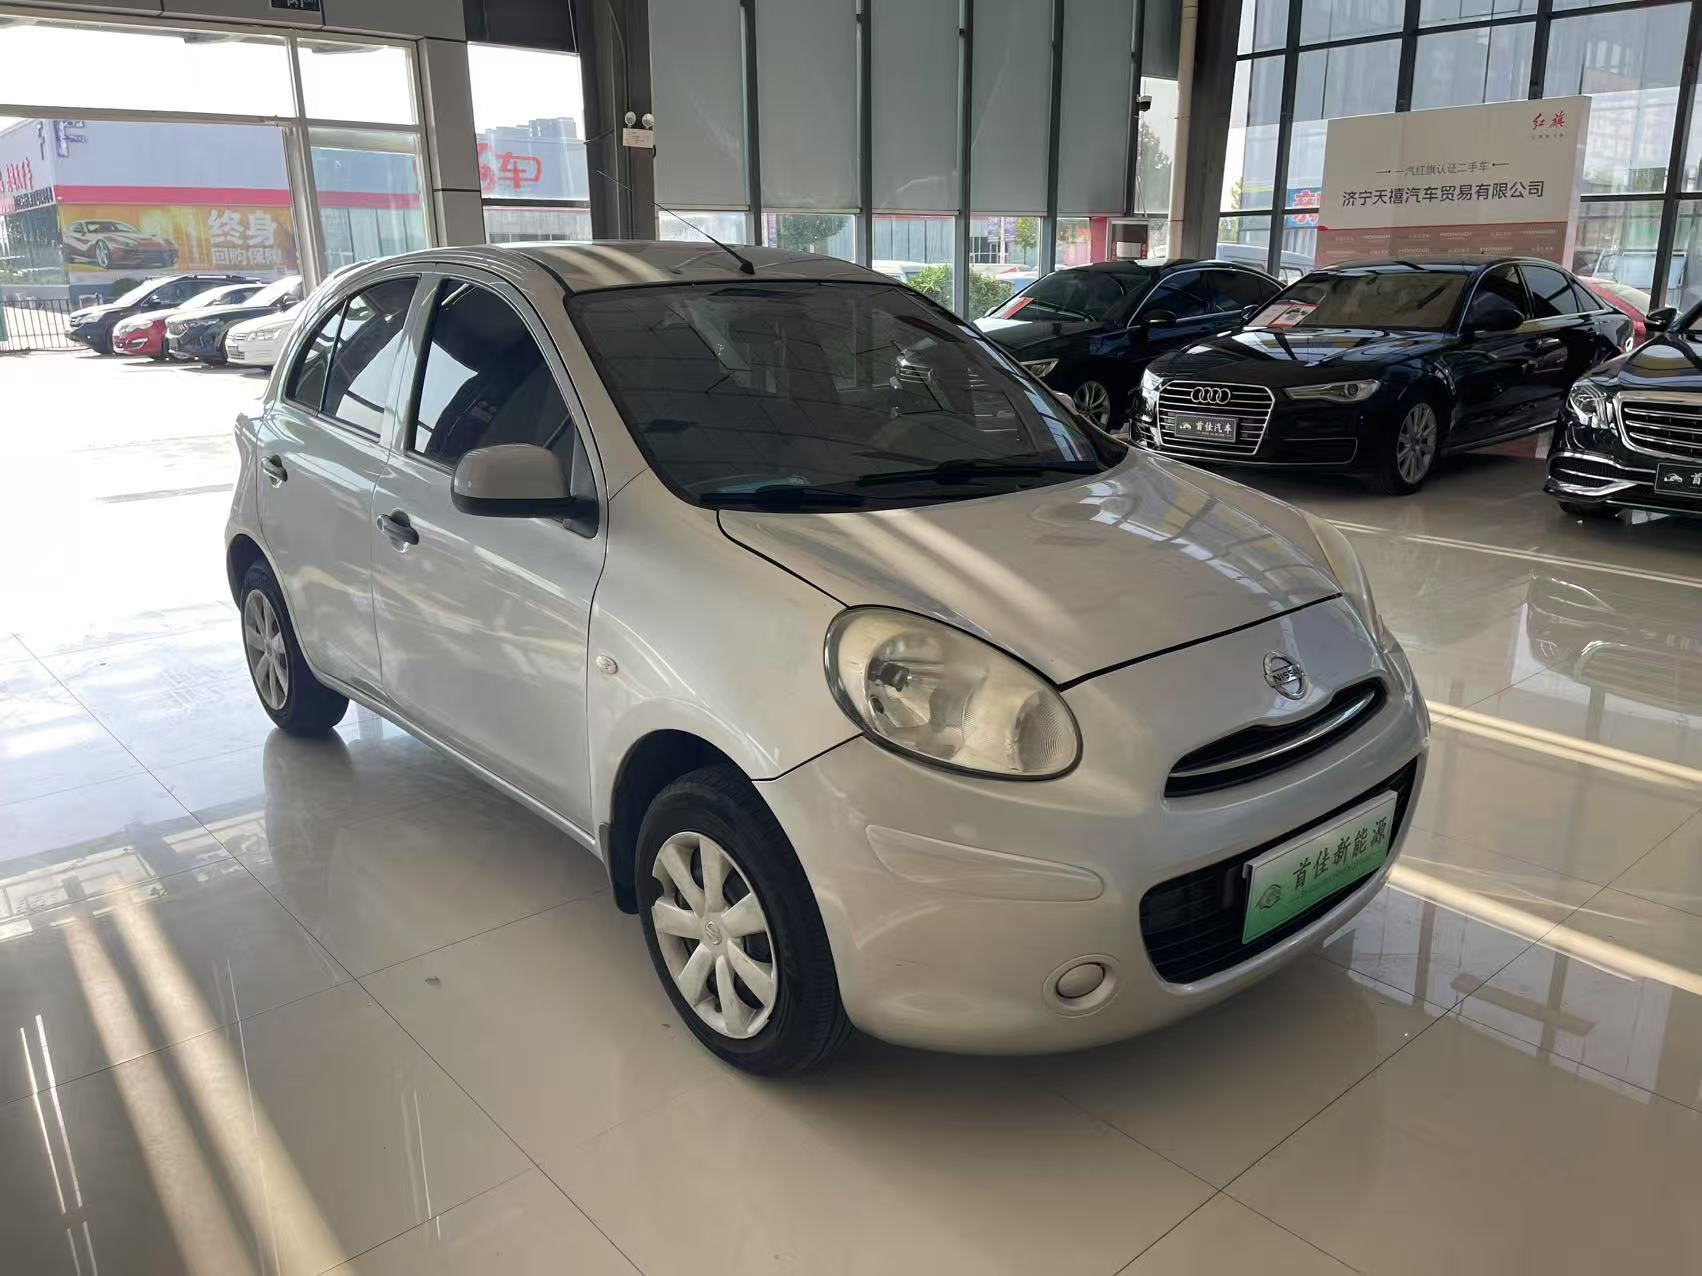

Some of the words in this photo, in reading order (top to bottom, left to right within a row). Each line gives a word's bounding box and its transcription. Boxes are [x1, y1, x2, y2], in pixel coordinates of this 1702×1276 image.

[1532, 109, 1566, 131] 红旗
[1395, 161, 1489, 176] 一汽红旗认证二手车
[1342, 180, 1545, 207] 济宁天禧汽车贸易有限公司
[208, 209, 277, 246] 终身
[1195, 421, 1232, 434] 首佳汽车
[1292, 816, 1388, 890] 首佳新能源
